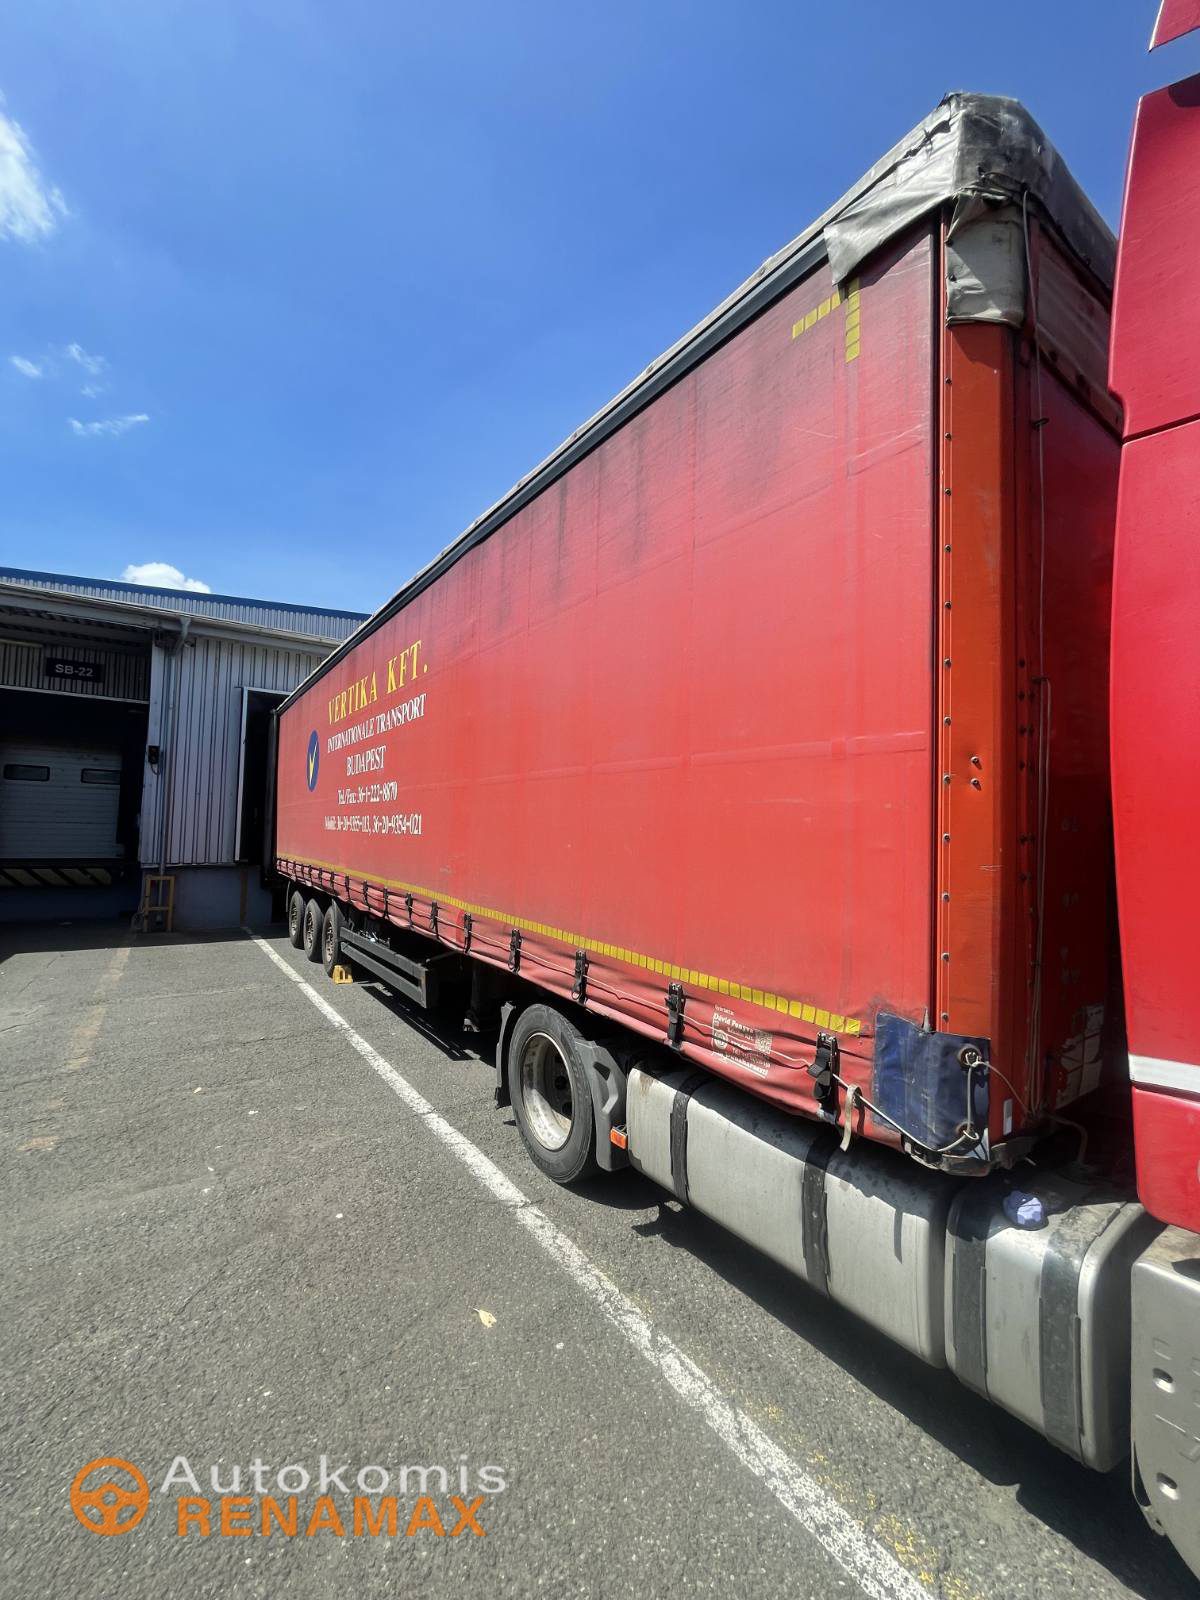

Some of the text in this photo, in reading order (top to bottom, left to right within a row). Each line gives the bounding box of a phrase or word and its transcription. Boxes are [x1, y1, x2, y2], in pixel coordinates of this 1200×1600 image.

[55, 663, 94, 677] SB-22
[328, 639, 429, 725] VERTIKA KFT.
[327, 693, 427, 754] INTERNATIONALE TRANSPORT
[346, 745, 387, 776] BUDAPEST
